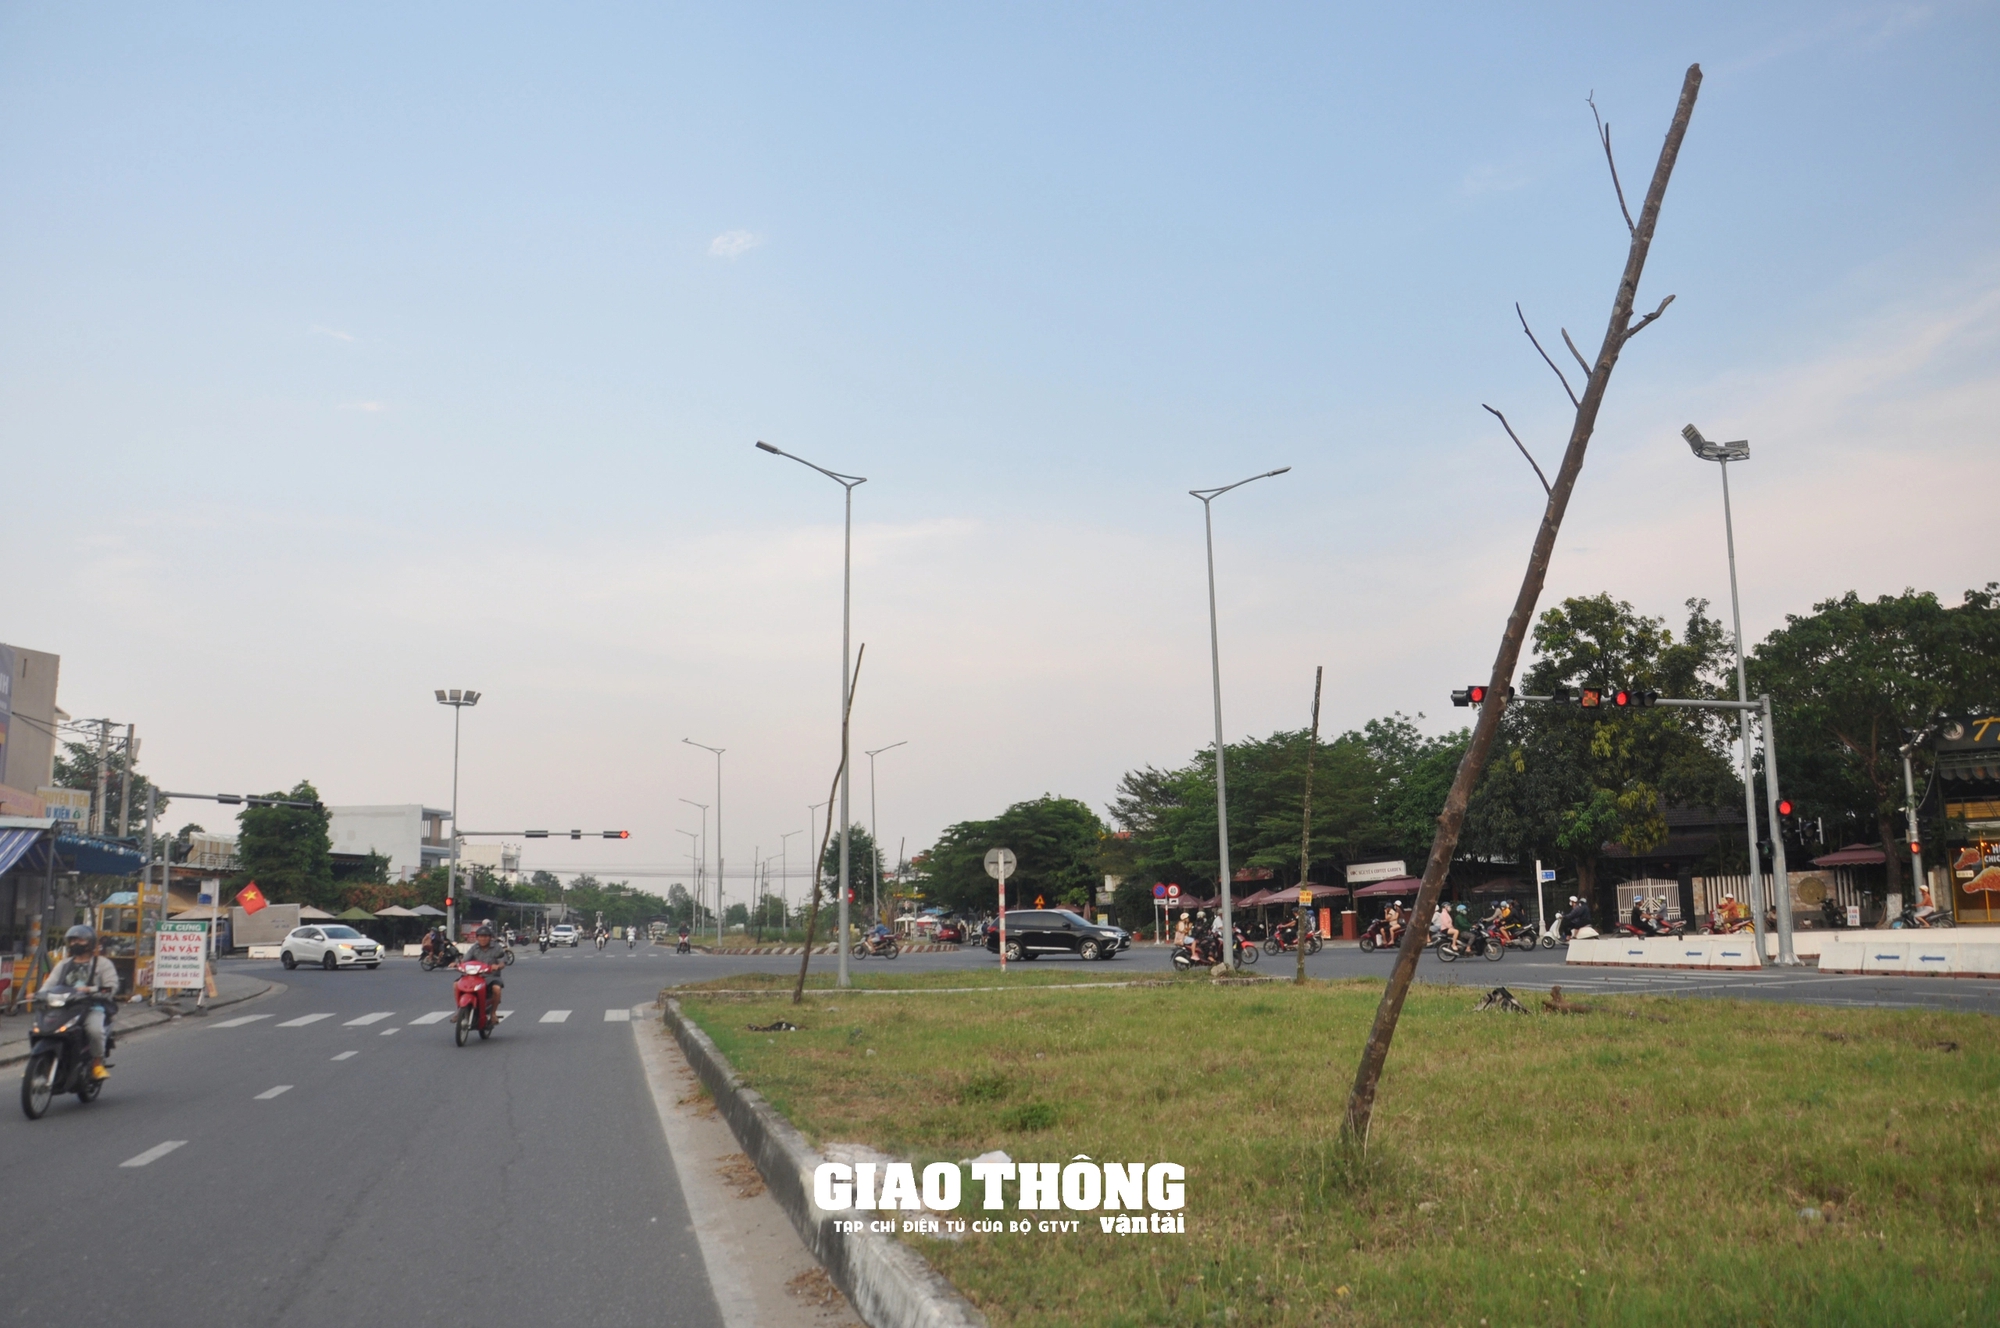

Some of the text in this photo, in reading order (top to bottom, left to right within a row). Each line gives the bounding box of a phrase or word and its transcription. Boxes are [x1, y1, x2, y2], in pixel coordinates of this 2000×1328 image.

[160, 933, 201, 941] TRÀ SỮA
[160, 944, 200, 954] ĂN VẶT
